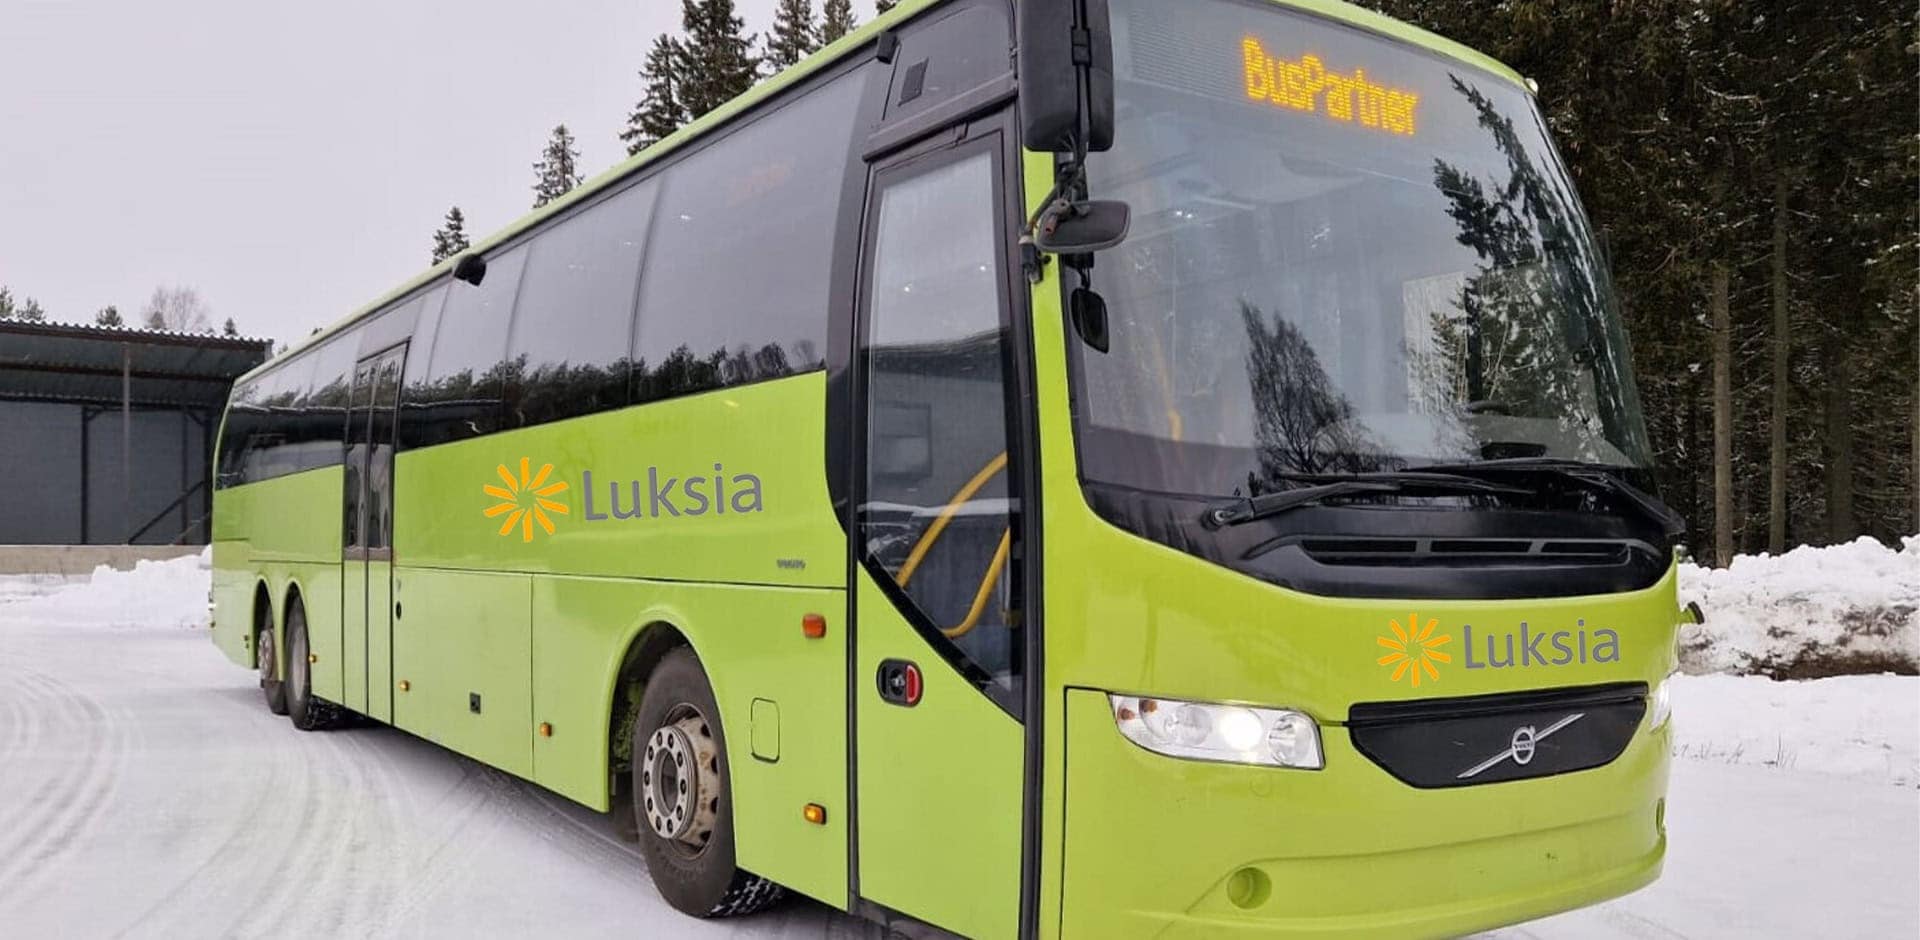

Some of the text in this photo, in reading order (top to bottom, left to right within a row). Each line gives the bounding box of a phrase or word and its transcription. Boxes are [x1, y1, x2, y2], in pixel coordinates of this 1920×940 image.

[1242, 37, 1418, 134] BusPartner
[583, 463, 763, 521] Luksia
[1464, 619, 1620, 669] Luksia
